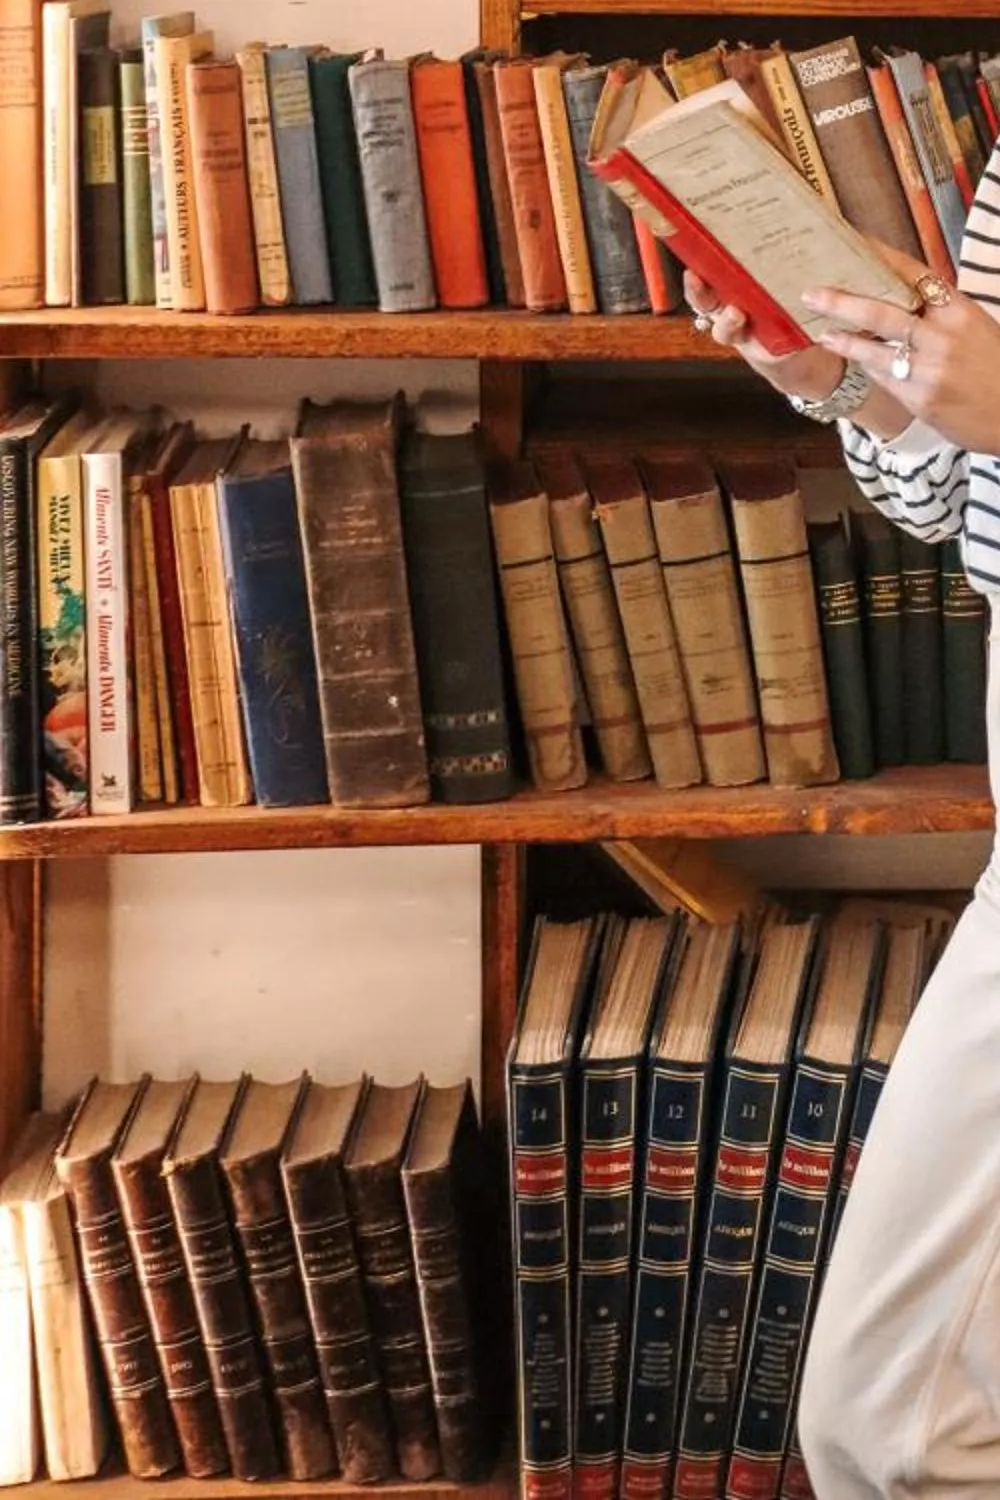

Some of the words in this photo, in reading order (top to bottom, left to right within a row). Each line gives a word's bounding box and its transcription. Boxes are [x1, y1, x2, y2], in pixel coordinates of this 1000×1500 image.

[171, 107, 187, 175] FRANÇAIS
[175, 180, 190, 241] AUTEURS
[1, 454, 16, 538] DISCOVERING
[59, 494, 72, 533] VIVEZ
[5, 539, 17, 567] NEW
[5, 569, 19, 620] WORLDS
[98, 614, 113, 672] Aliments
[100, 675, 116, 733] DANGER
[531, 1107, 548, 1122] 14
[602, 1101, 618, 1117] 13
[667, 1104, 684, 1120] 12
[740, 1103, 756, 1120] 11
[807, 1101, 825, 1118] 10
